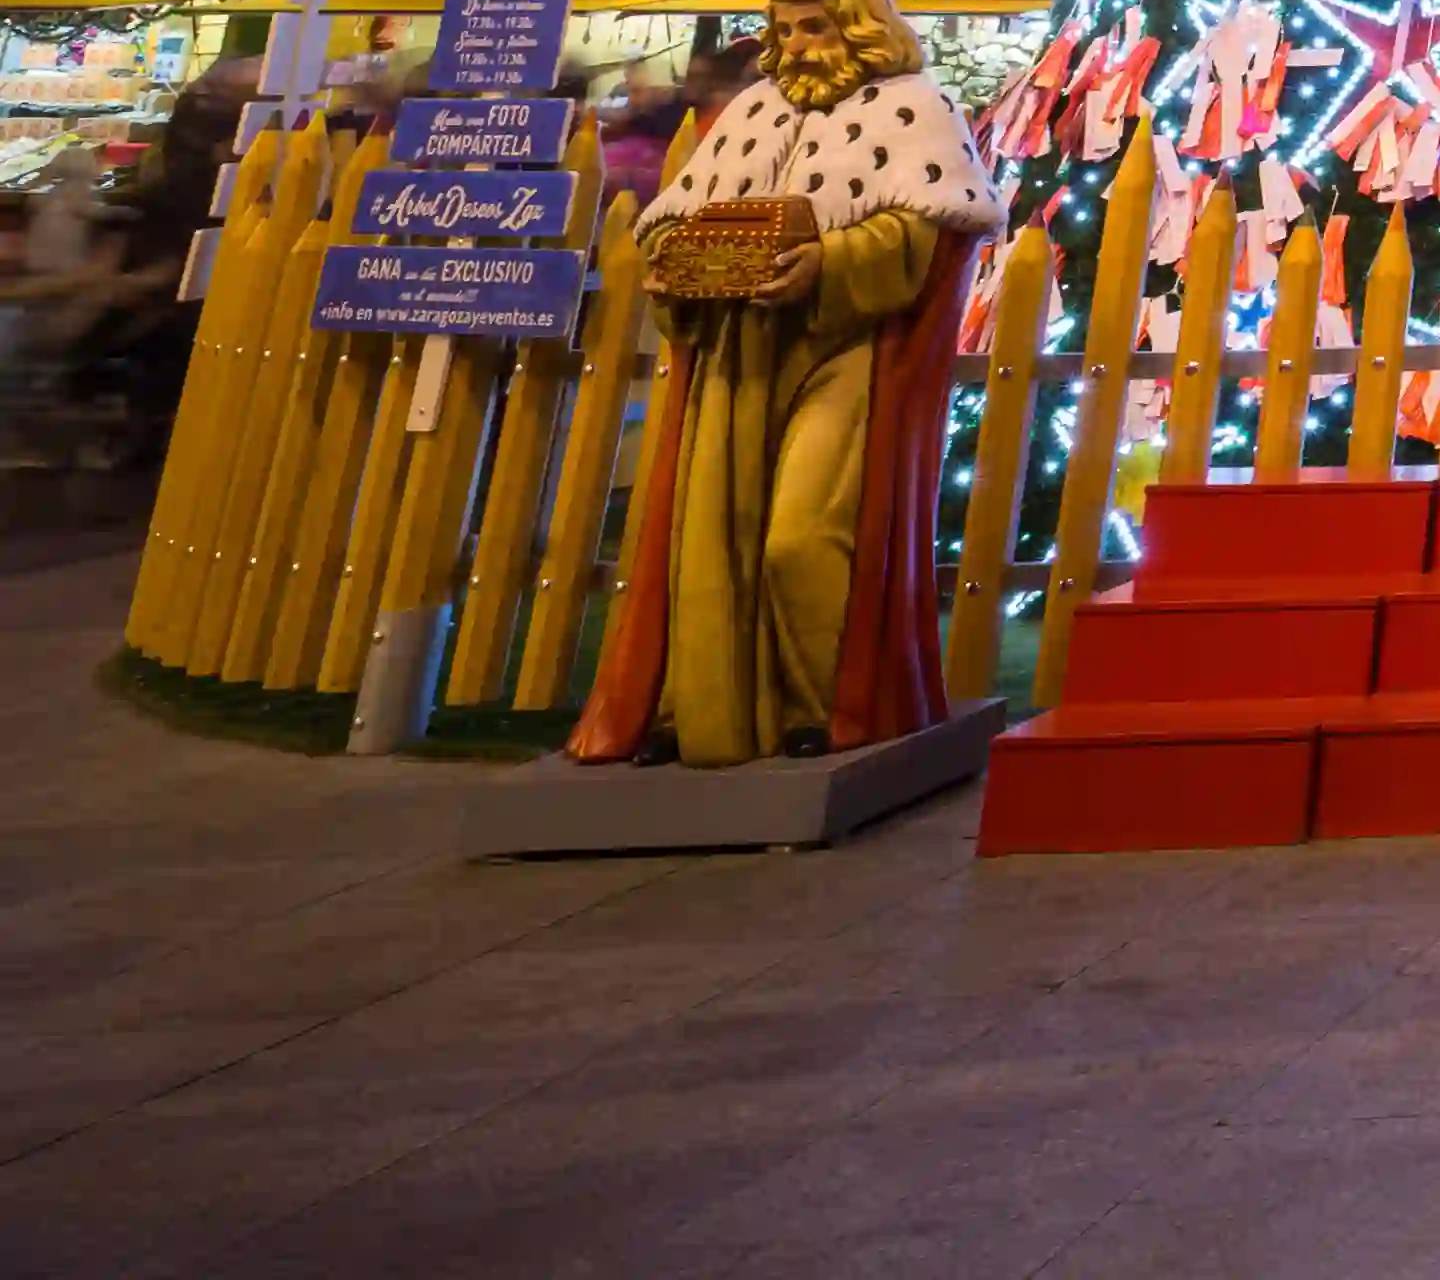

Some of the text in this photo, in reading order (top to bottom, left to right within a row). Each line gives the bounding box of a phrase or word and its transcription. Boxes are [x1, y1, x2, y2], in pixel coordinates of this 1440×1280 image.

[487, 104, 531, 127] FOTO
[426, 128, 532, 157] COMPÁRTELA
[357, 257, 401, 282] GANA
[440, 258, 534, 284] EXCLUSIVO
[319, 300, 555, 329] +info en www.zaragozayeventos.es
